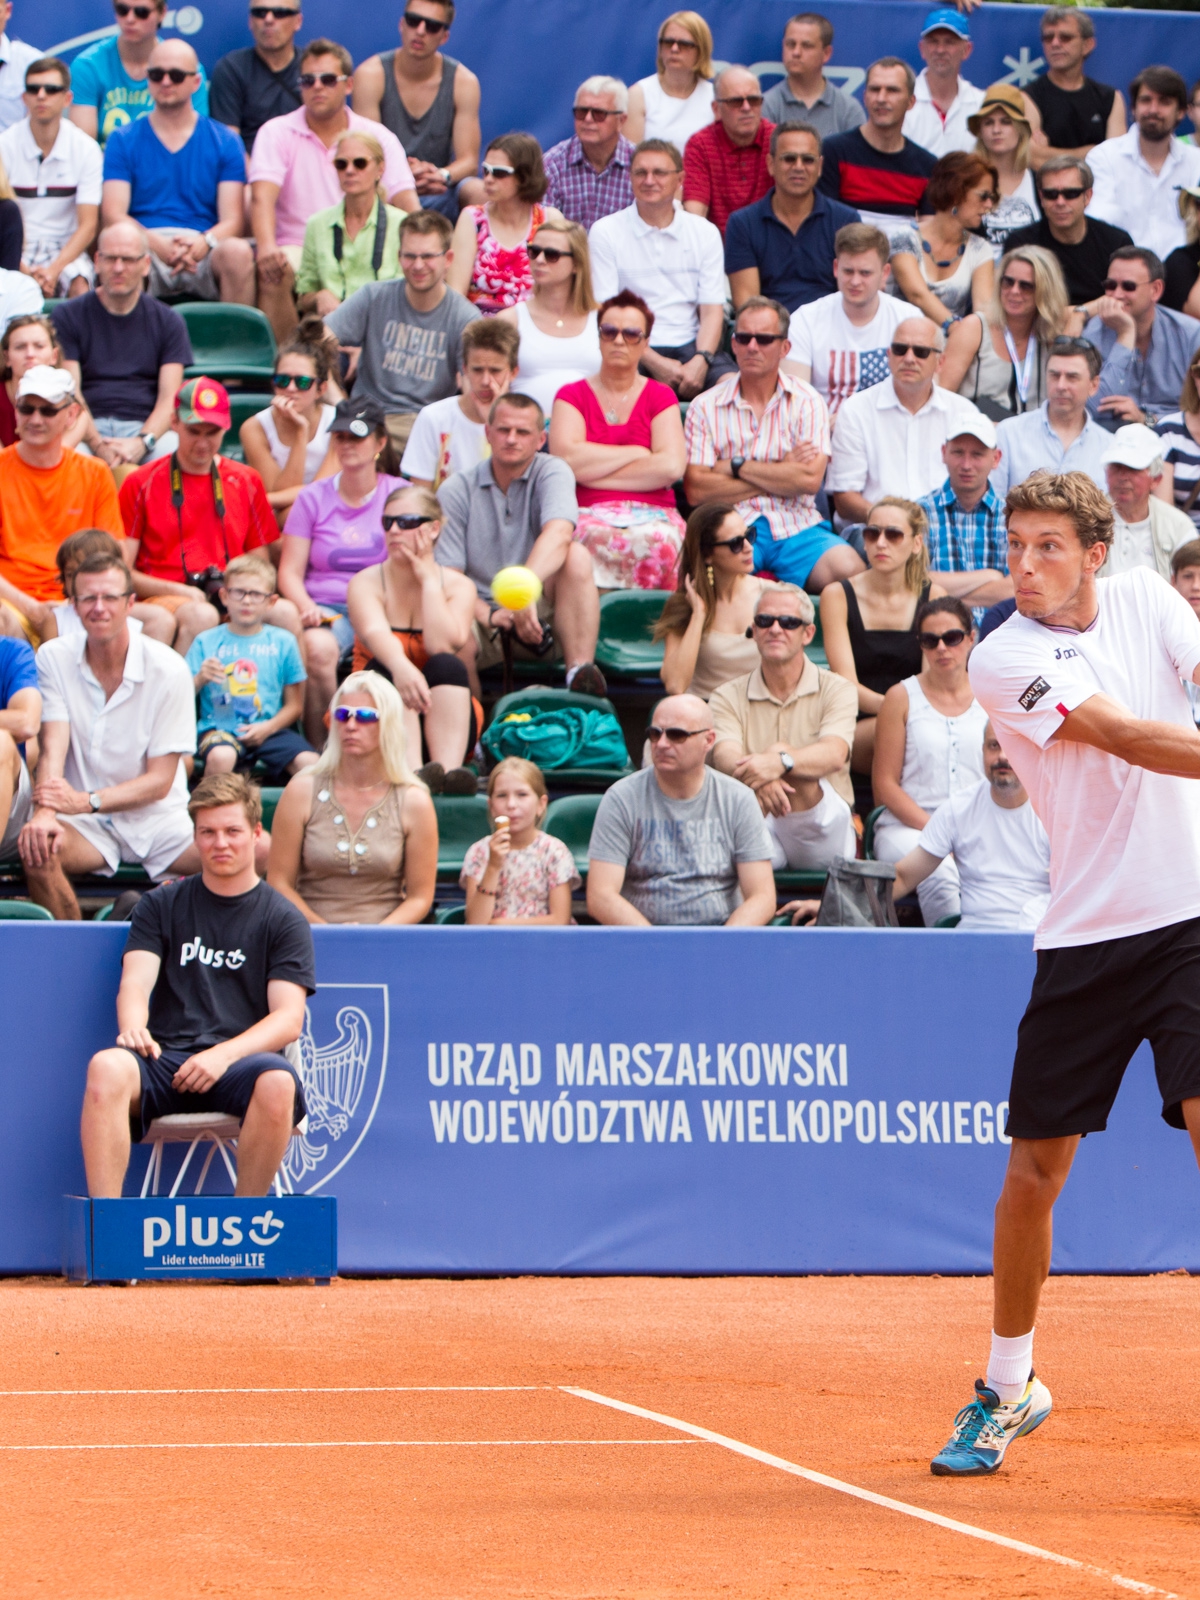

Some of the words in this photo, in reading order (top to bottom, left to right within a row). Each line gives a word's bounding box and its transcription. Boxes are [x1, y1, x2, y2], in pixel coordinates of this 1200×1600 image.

[1020, 679, 1046, 708] BOVET
[180, 936, 225, 968] plus
[428, 1043, 542, 1095] URZĄD
[555, 1042, 848, 1087] MARSZAŁKOWSKI
[429, 1091, 693, 1144] WOJEWÓDZTWA
[143, 1205, 243, 1257] plus
[162, 1255, 186, 1265] Lider
[188, 1254, 242, 1267] technologii
[245, 1253, 265, 1267] LTE
